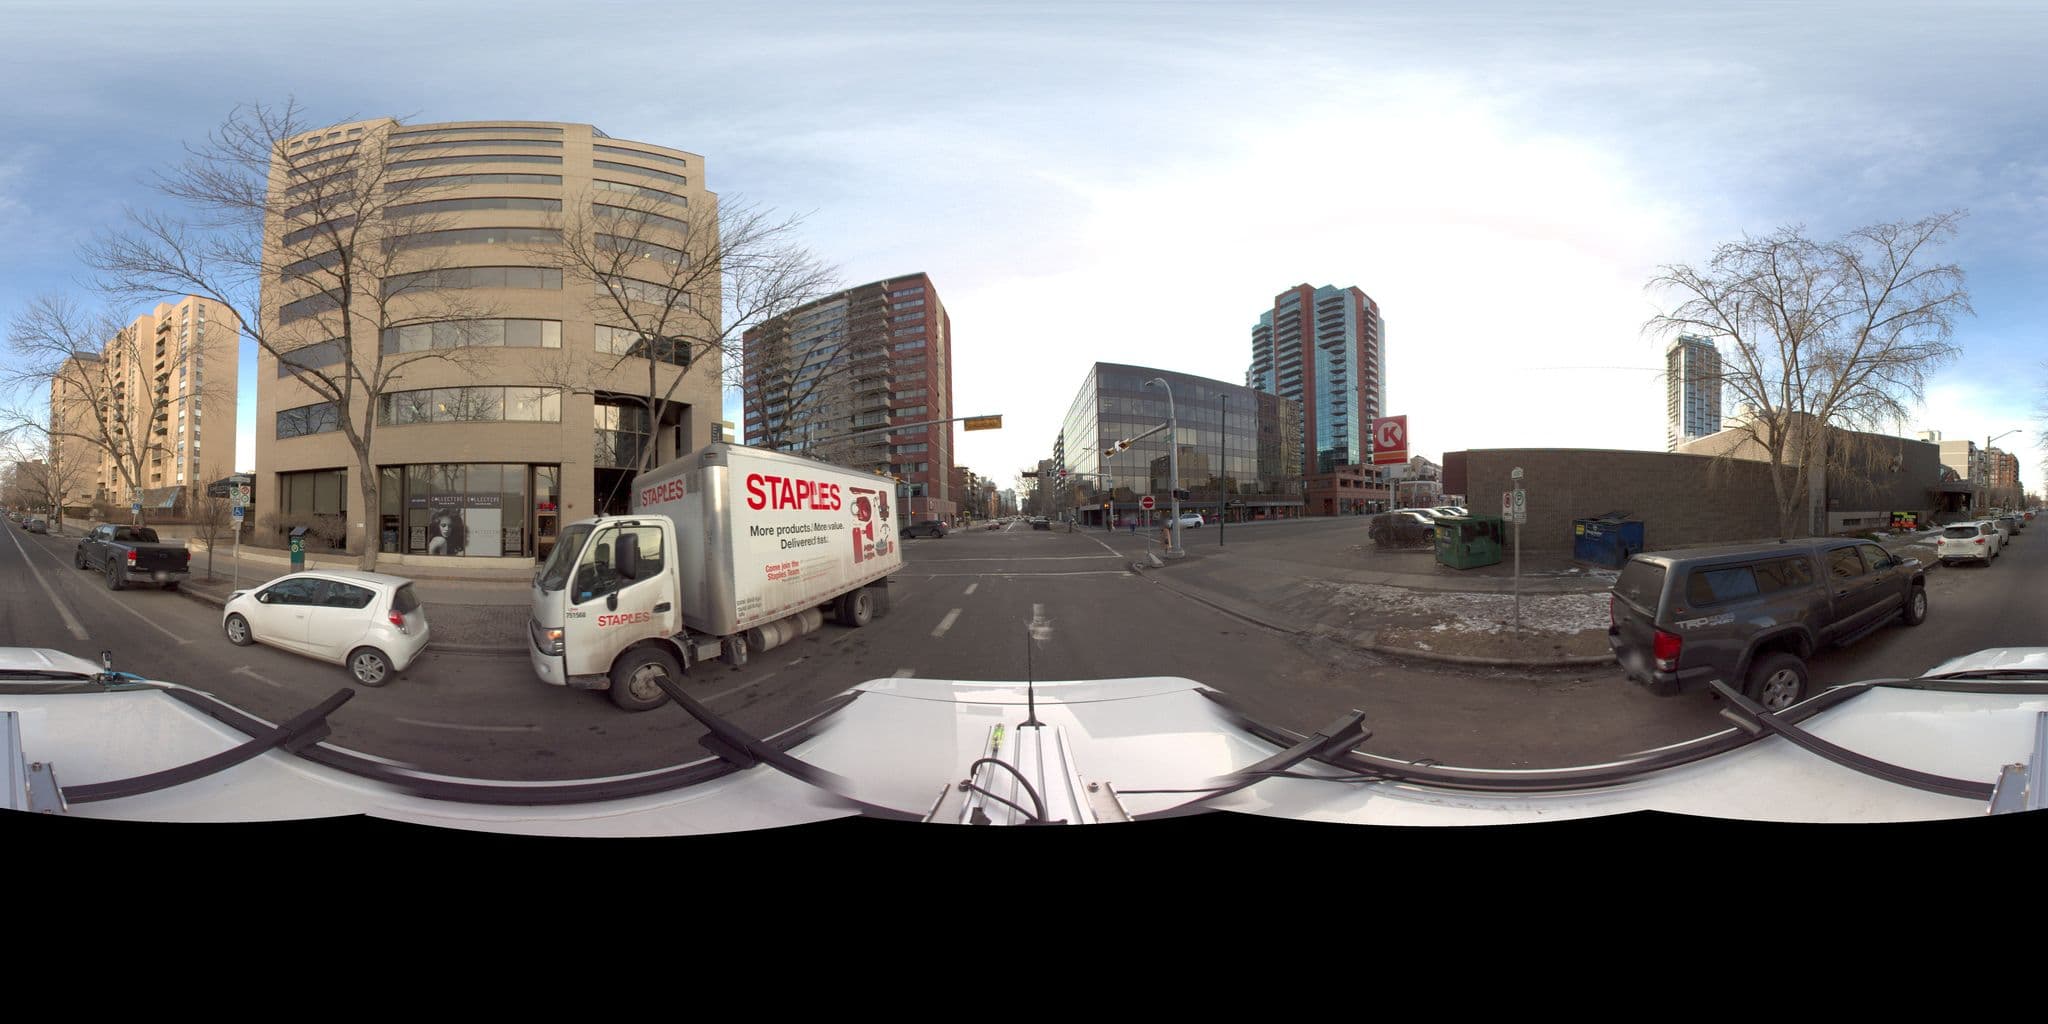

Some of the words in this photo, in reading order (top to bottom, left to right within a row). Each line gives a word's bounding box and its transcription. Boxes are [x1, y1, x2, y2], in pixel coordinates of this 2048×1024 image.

[1381, 424, 1401, 446] K
[641, 479, 684, 507] STAPLES
[746, 473, 842, 511] STAPLES
[750, 525, 775, 537] More
[780, 536, 817, 550] Delivered
[598, 611, 651, 627] STAPLES
